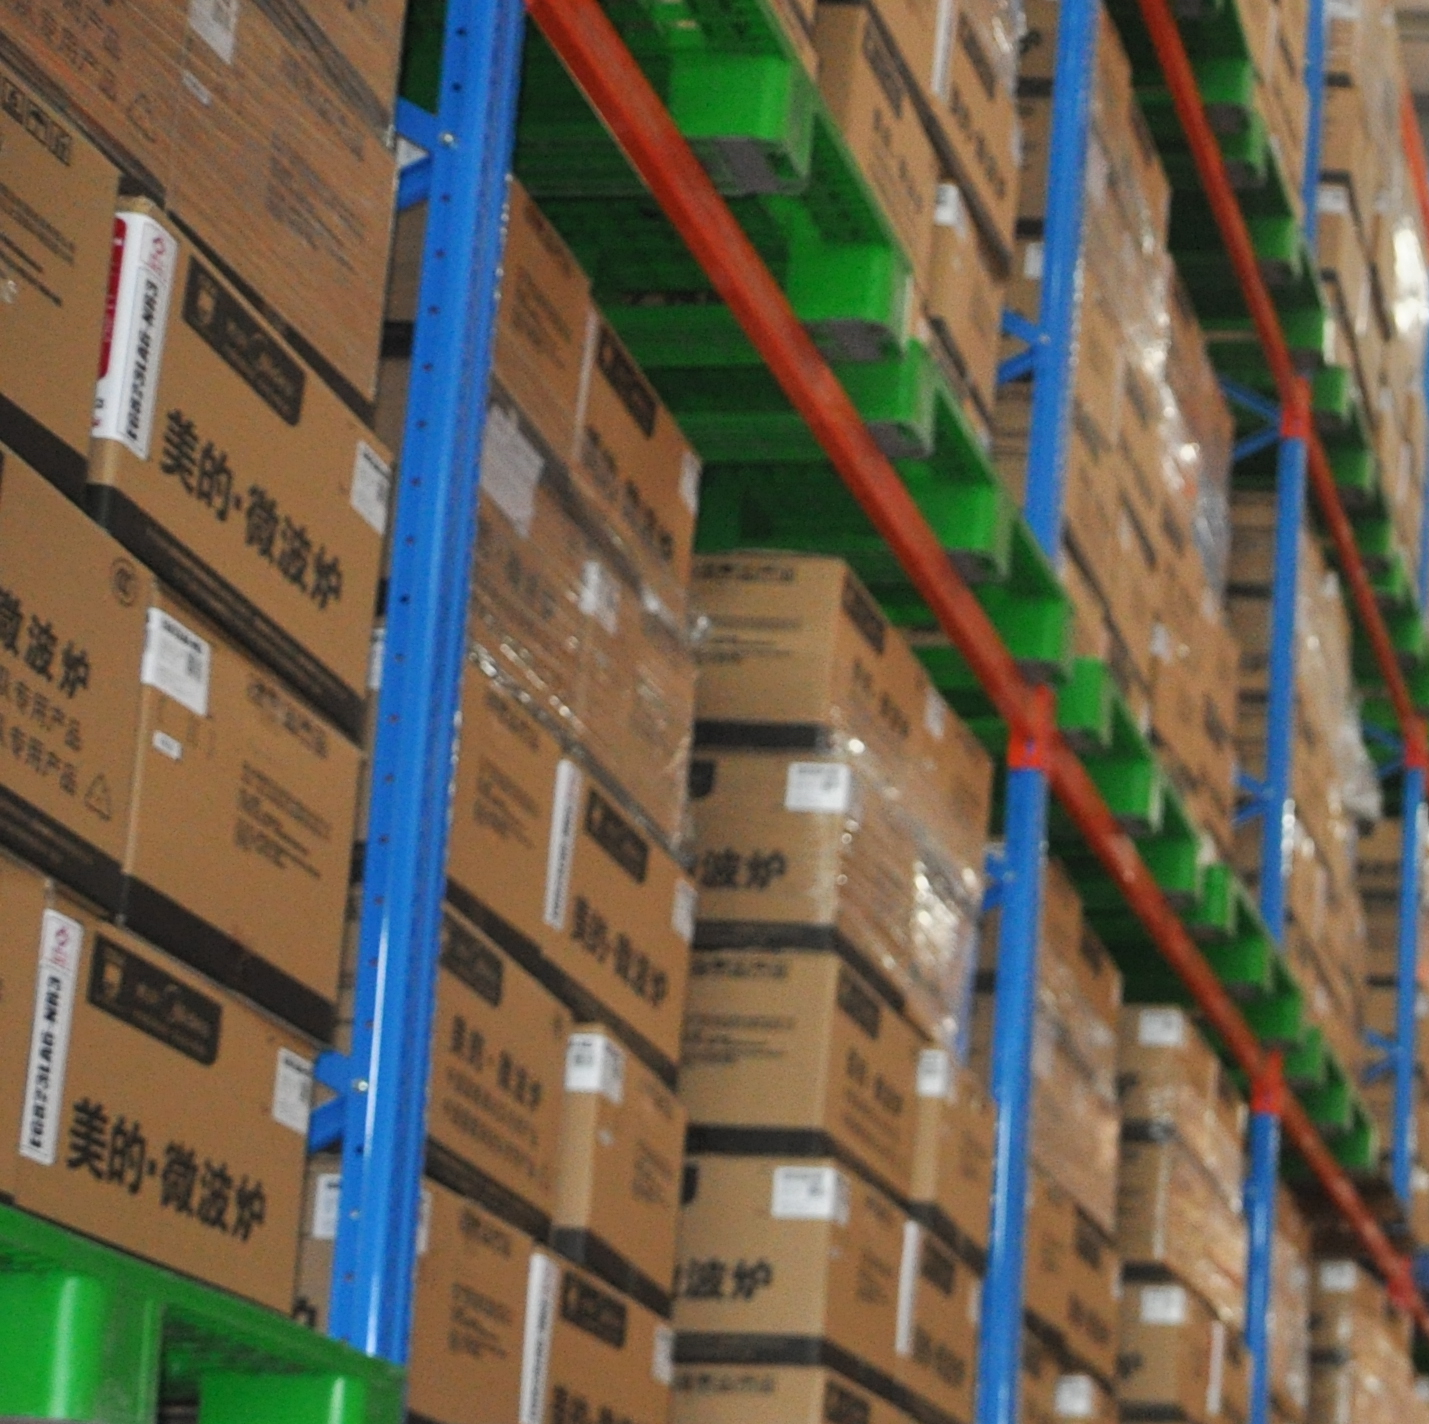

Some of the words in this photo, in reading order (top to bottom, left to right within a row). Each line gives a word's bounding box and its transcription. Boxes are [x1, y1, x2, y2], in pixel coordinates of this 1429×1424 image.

[159, 408, 344, 610] 美的·微波炉
[66, 1097, 267, 1243] 美的·微波炉
